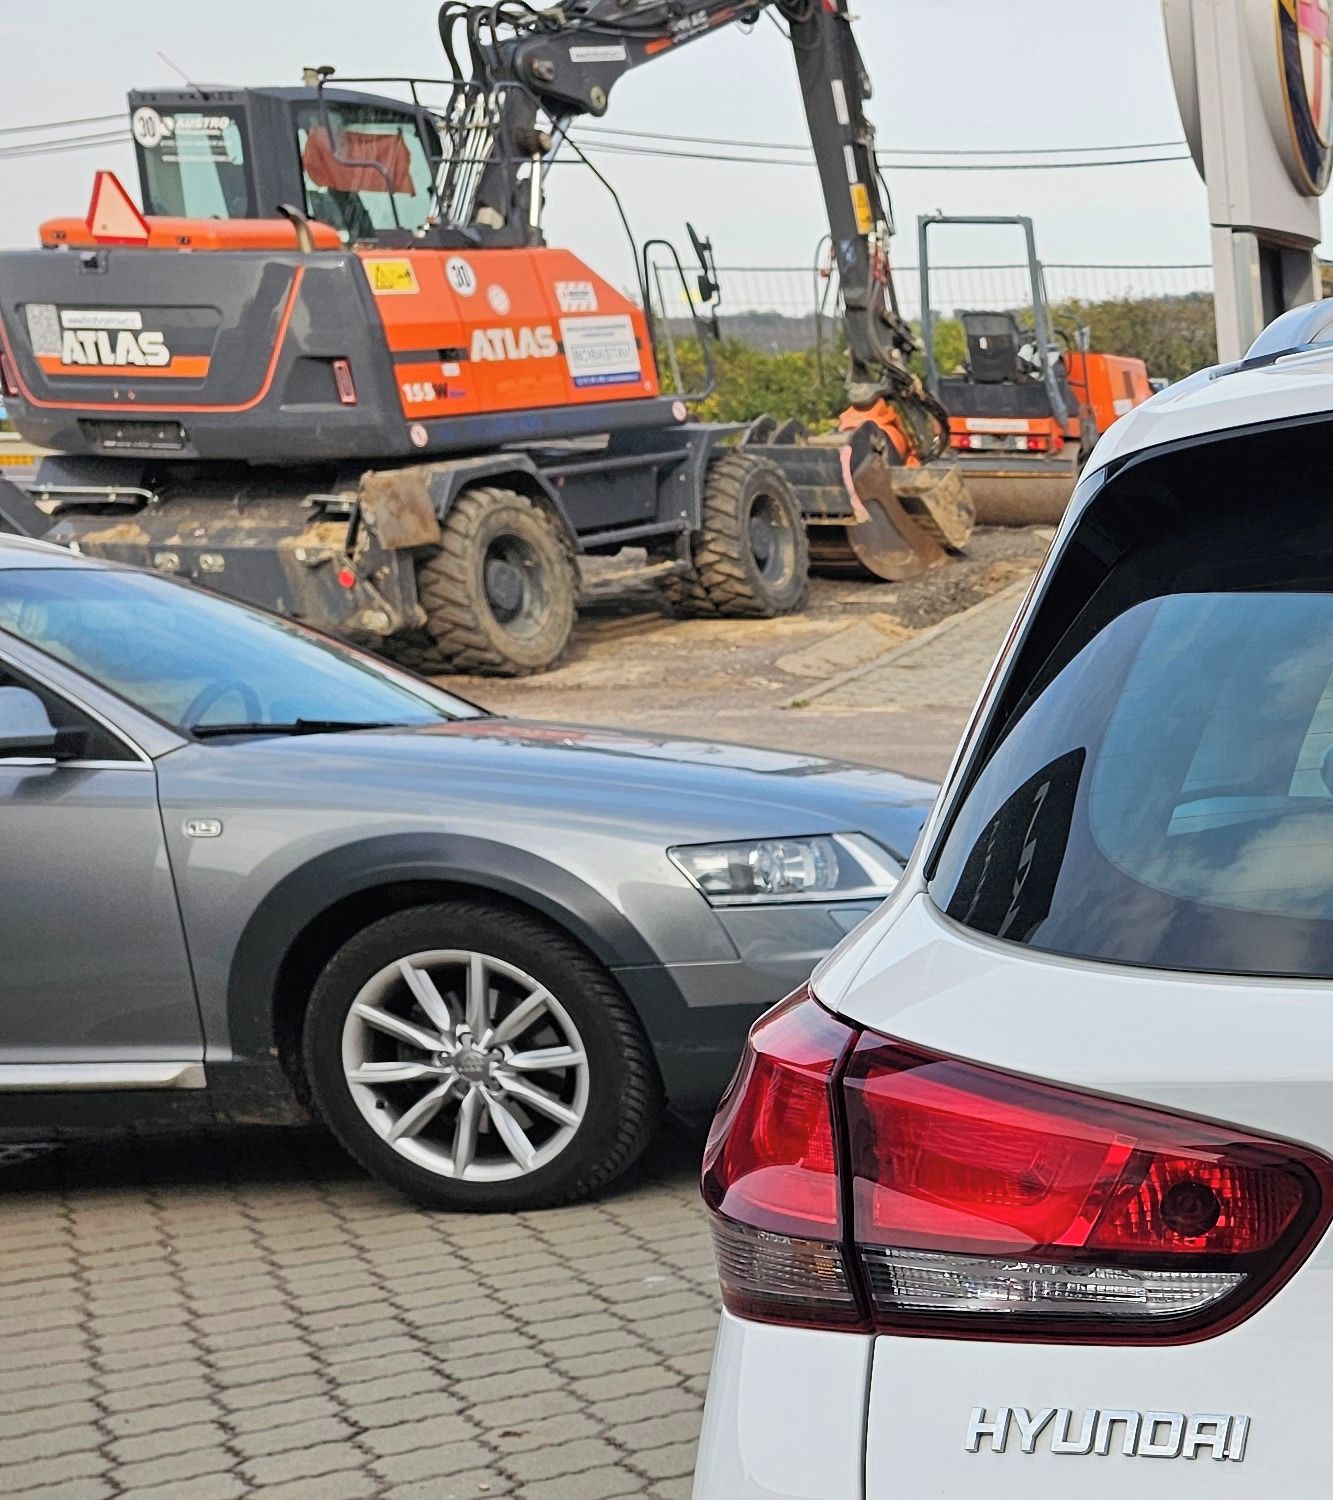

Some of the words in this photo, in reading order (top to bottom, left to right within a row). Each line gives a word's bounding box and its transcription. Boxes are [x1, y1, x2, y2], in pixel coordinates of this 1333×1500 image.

[452, 264, 471, 289] 30
[62, 330, 170, 366] ATLAS
[470, 326, 559, 362] ATLAS
[964, 1406, 1251, 1462] HYUNDAI
